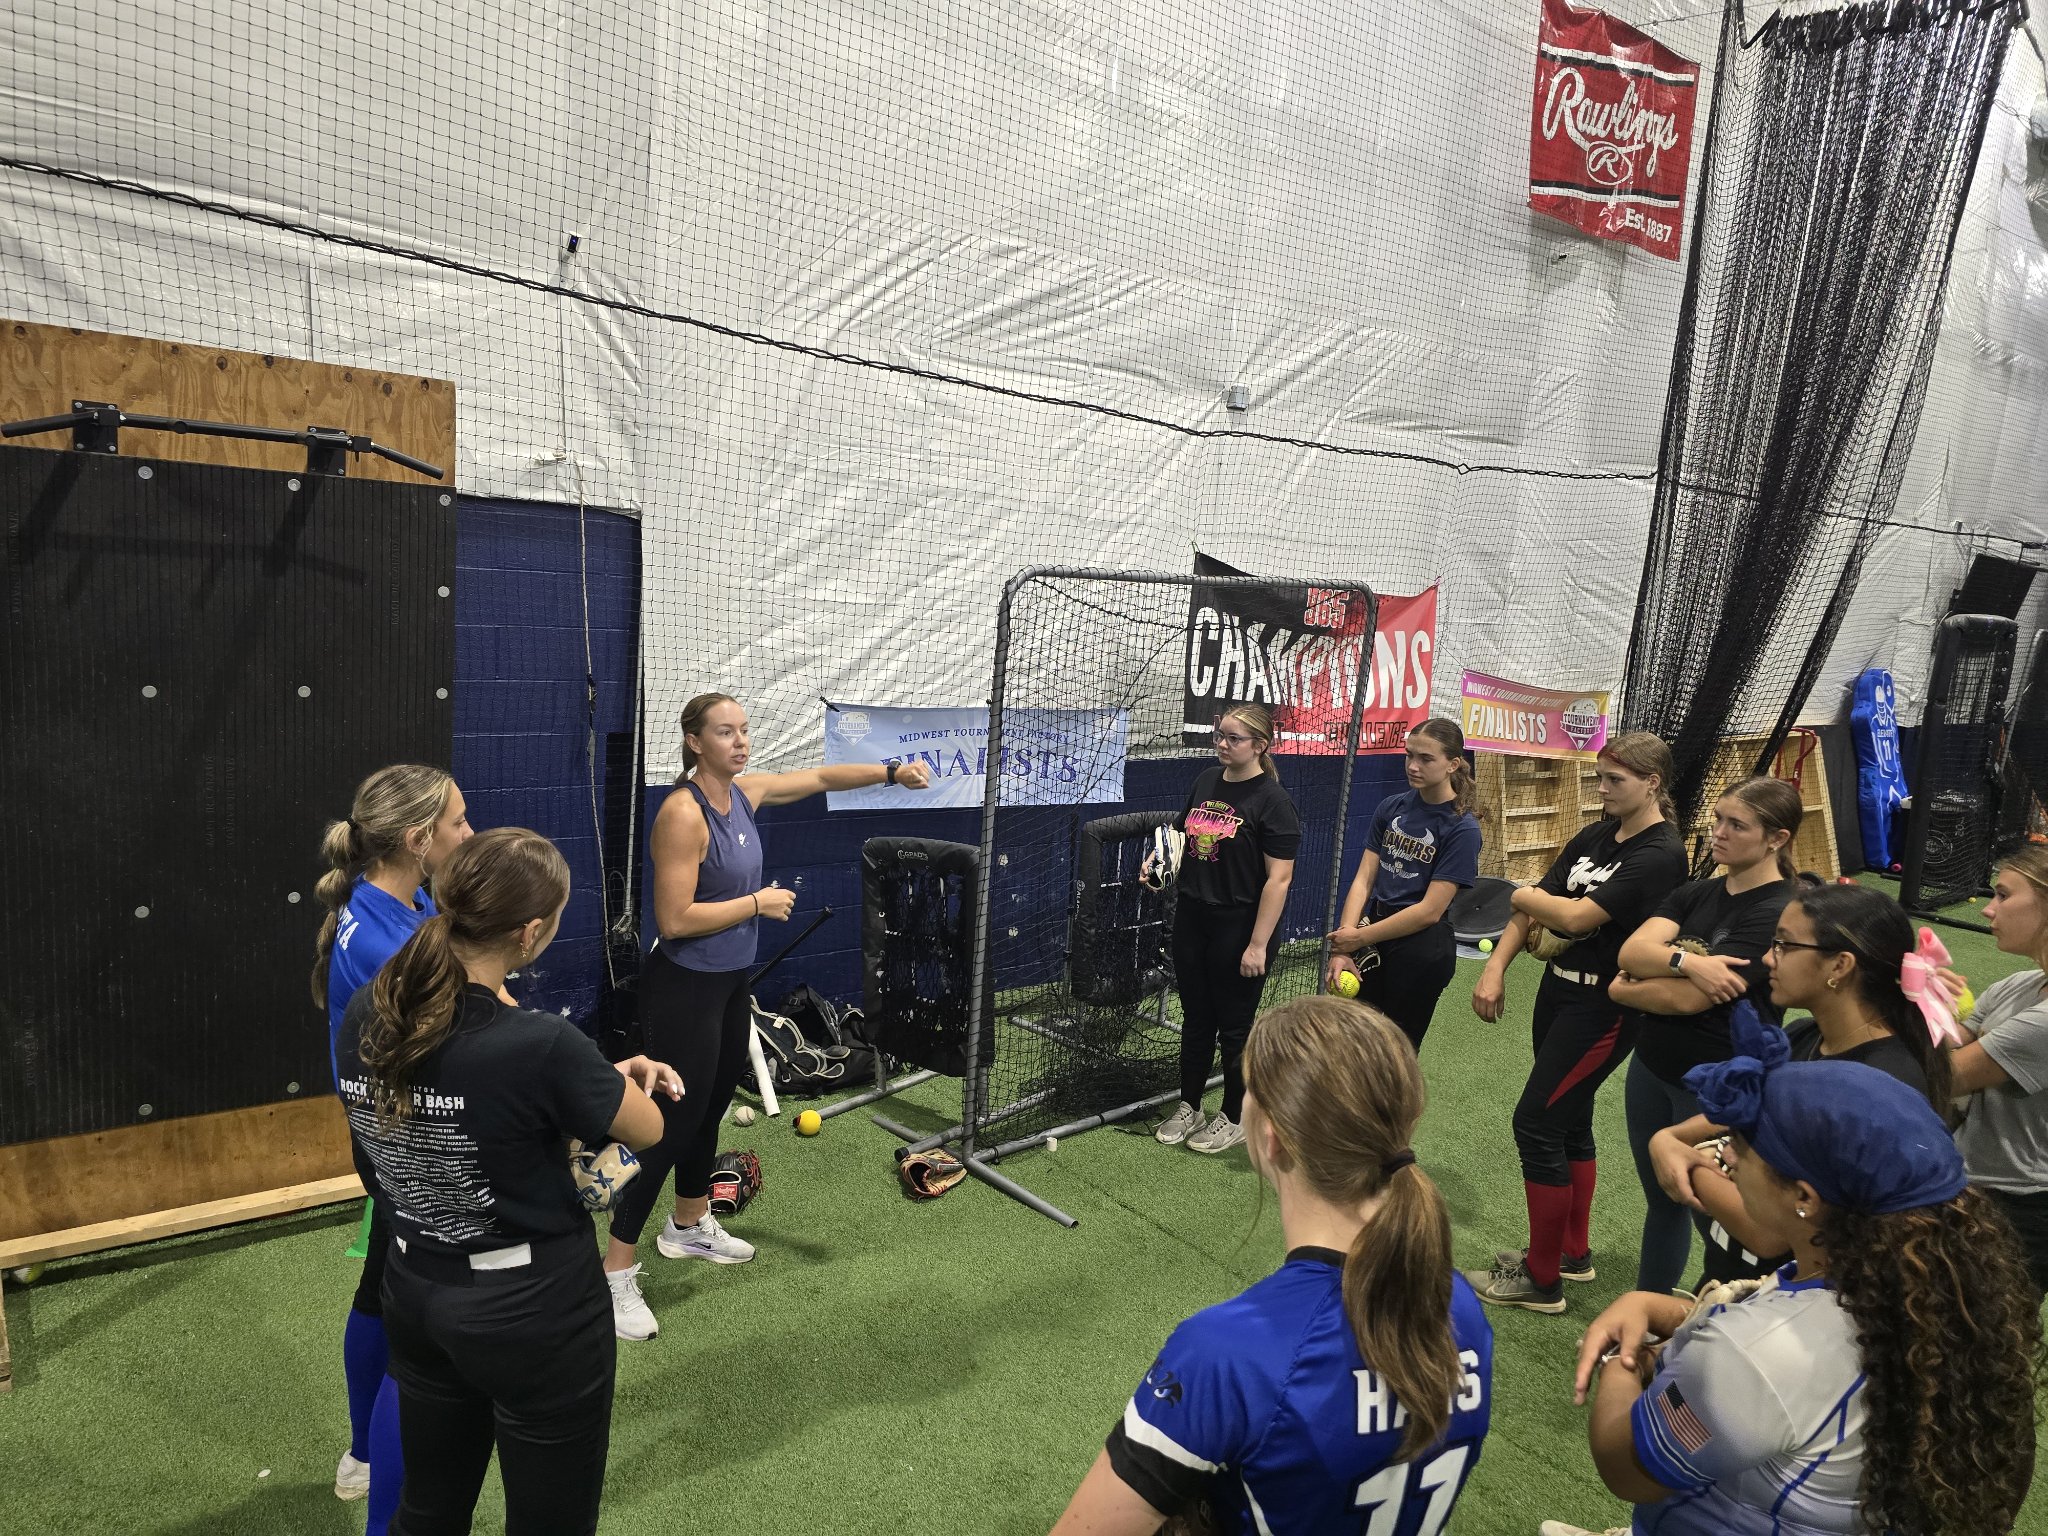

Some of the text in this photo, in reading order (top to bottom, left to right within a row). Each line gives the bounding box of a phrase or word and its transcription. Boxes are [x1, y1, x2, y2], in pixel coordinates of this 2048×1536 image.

[1542, 67, 1678, 177] Rawlings
[1646, 217, 1673, 242] 1887
[1466, 682, 1495, 697] MIDWEST
[1494, 688, 1540, 706] TOURNAMENT
[1467, 703, 1547, 744] FINALISTS
[1564, 713, 1600, 727] TOURNAMENT
[899, 729, 951, 743] MIDWEST
[954, 728, 1024, 738] TOURNMENT
[1324, 721, 1408, 749] CHLLENGE
[1882, 740, 1892, 761] 11
[1382, 830, 1436, 864] RANGERS
[426, 1095, 465, 1110] BASH
[1354, 1445, 1470, 1536] 11
